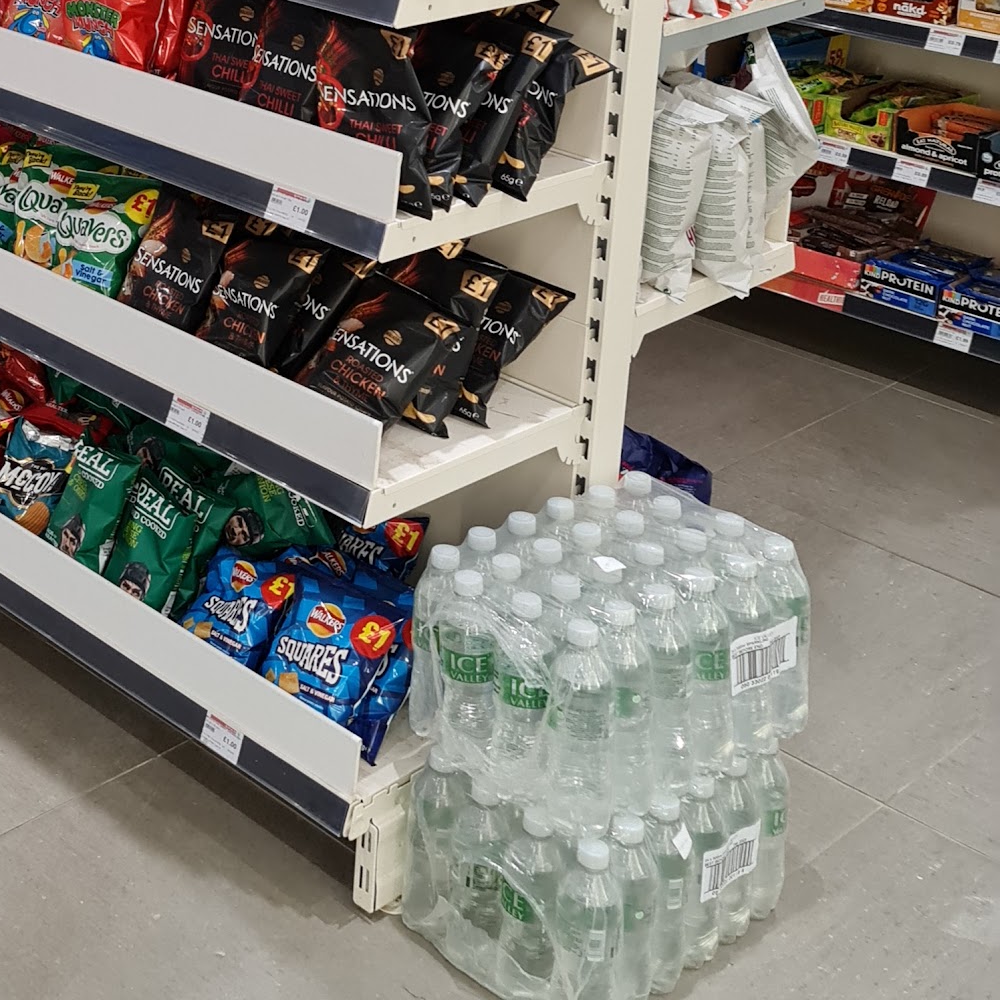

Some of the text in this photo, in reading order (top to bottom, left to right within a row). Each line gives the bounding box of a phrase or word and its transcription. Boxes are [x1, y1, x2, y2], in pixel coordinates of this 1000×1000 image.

[66, 0, 121, 30] MONSTER
[526, 34, 548, 57] £1
[257, 93, 295, 117] CHILLI
[317, 81, 417, 112] SENSATIONS
[349, 118, 375, 132] THAI
[901, 143, 932, 157] almond
[932, 150, 938, 158] &
[938, 151, 968, 167] apricot
[132, 194, 159, 218] £1
[292, 205, 309, 217] £1.00
[58, 212, 127, 249] Quavers
[80, 263, 95, 274] Salt
[134, 246, 203, 295] SENSATIONS
[464, 274, 492, 299] £1
[880, 270, 935, 296] PROTEIN
[212, 284, 279, 320] SENSATIONS
[960, 296, 1000, 318] PROTE
[330, 358, 387, 399] CHICKEN
[345, 354, 385, 383] ROASTED
[187, 415, 203, 428] £1.00
[393, 522, 420, 551] £1
[268, 575, 294, 599] £1
[204, 595, 257, 633] SQUARES
[310, 607, 345, 635] WALKERS
[357, 621, 389, 652] £1
[277, 637, 349, 685] SQUARES
[450, 653, 488, 673] ICE
[450, 671, 488, 682] VALLEY
[314, 689, 336, 703] VINEGAR
[222, 735, 238, 750] £1.00
